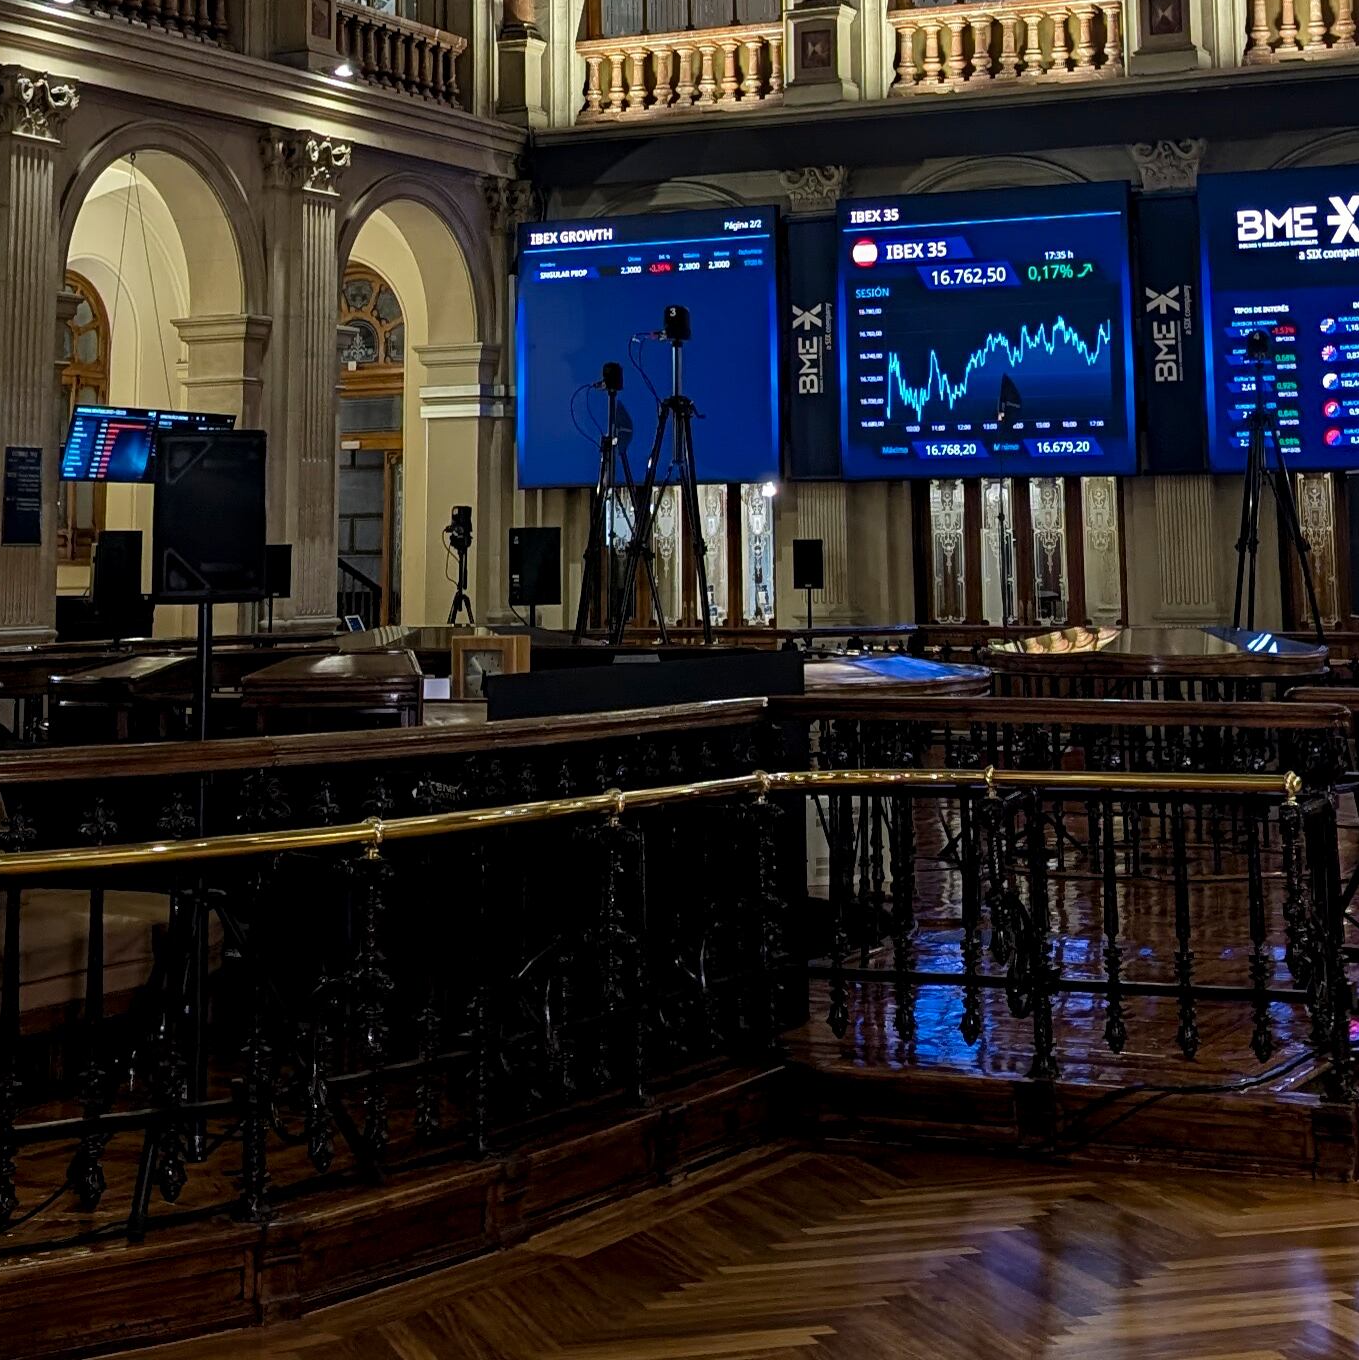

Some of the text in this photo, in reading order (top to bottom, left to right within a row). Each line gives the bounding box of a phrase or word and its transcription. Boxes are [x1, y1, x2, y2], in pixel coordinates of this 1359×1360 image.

[850, 208, 899, 223] IBEX 35
[1236, 205, 1319, 242] BME
[530, 219, 762, 246] IBEX GROWTH Página 2/2
[885, 241, 947, 260] IBEX 35
[1044, 250, 1074, 260] 17:35 h
[1306, 249, 1322, 260] SIX
[931, 266, 1006, 286] 16.762,50
[1027, 264, 1073, 282] 0,17%
[855, 287, 890, 299] SESIÓN
[670, 307, 677, 317] 3
[1152, 320, 1178, 382] BME
[797, 336, 819, 394] BME
[925, 443, 977, 457] 16.768,20
[1037, 441, 1090, 455] 16.679,20
